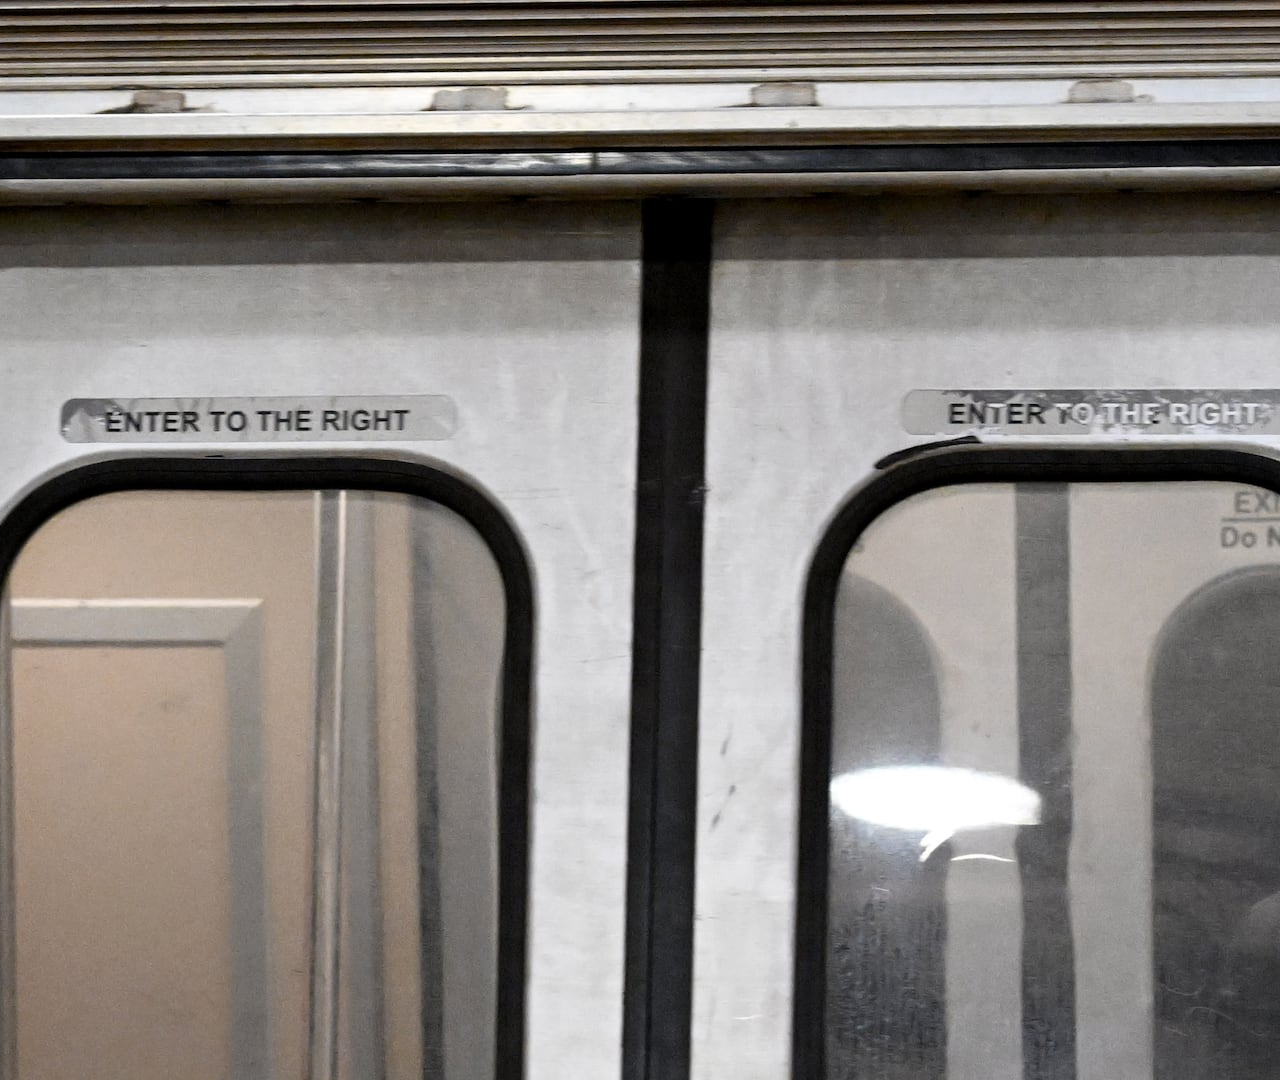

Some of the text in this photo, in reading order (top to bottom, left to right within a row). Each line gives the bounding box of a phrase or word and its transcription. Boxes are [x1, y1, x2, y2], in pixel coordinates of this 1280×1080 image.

[104, 409, 410, 433] ENTER TO THE RIGHT
[948, 402, 1260, 425] ENTER TO THE RIGHT
[1220, 526, 1258, 548] Do
